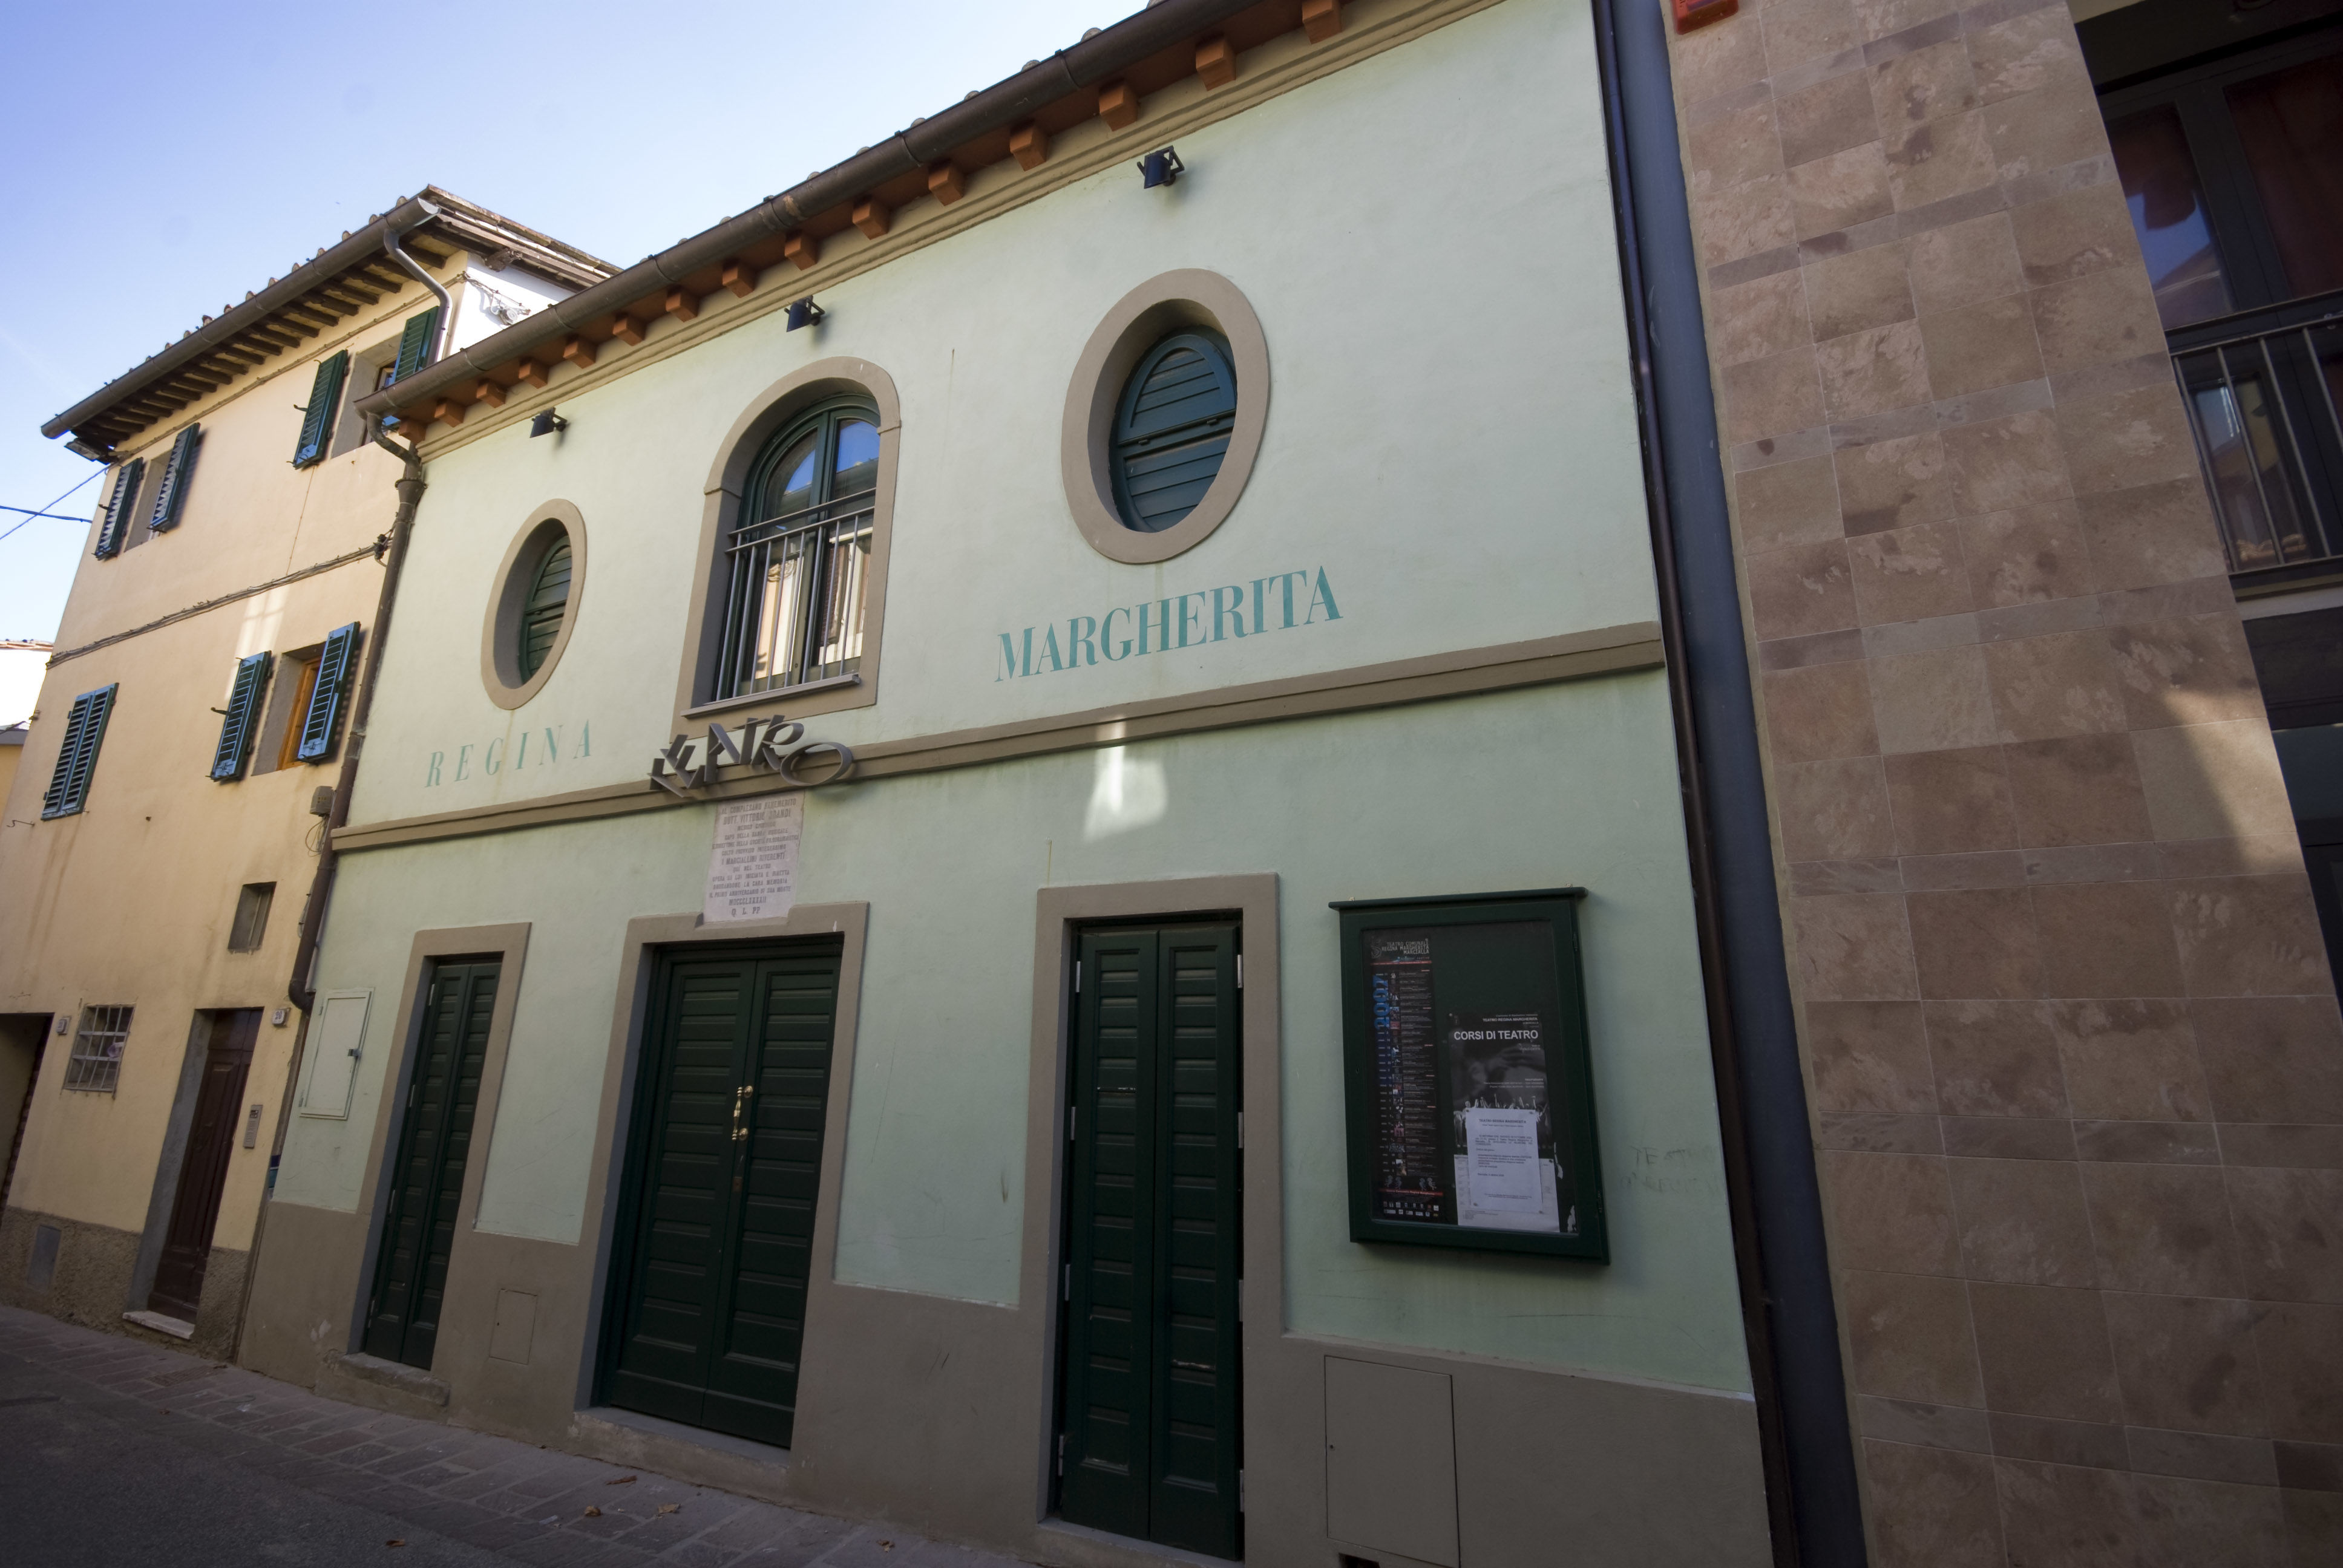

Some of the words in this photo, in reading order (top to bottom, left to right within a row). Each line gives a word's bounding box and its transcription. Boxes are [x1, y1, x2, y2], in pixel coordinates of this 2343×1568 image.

[994, 566, 1343, 682] MARGHERITA
[425, 719, 591, 788] REGINA
[740, 812, 765, 823] VITTORIO
[726, 855, 757, 865] MARCIALLINI
[759, 852, 785, 861] RIVERENTI
[1372, 975, 1389, 1031] 2007
[1453, 1031, 1484, 1040] CORSI
[1486, 1030, 1496, 1040] DI
[1498, 1030, 1539, 1039] TEATRO
